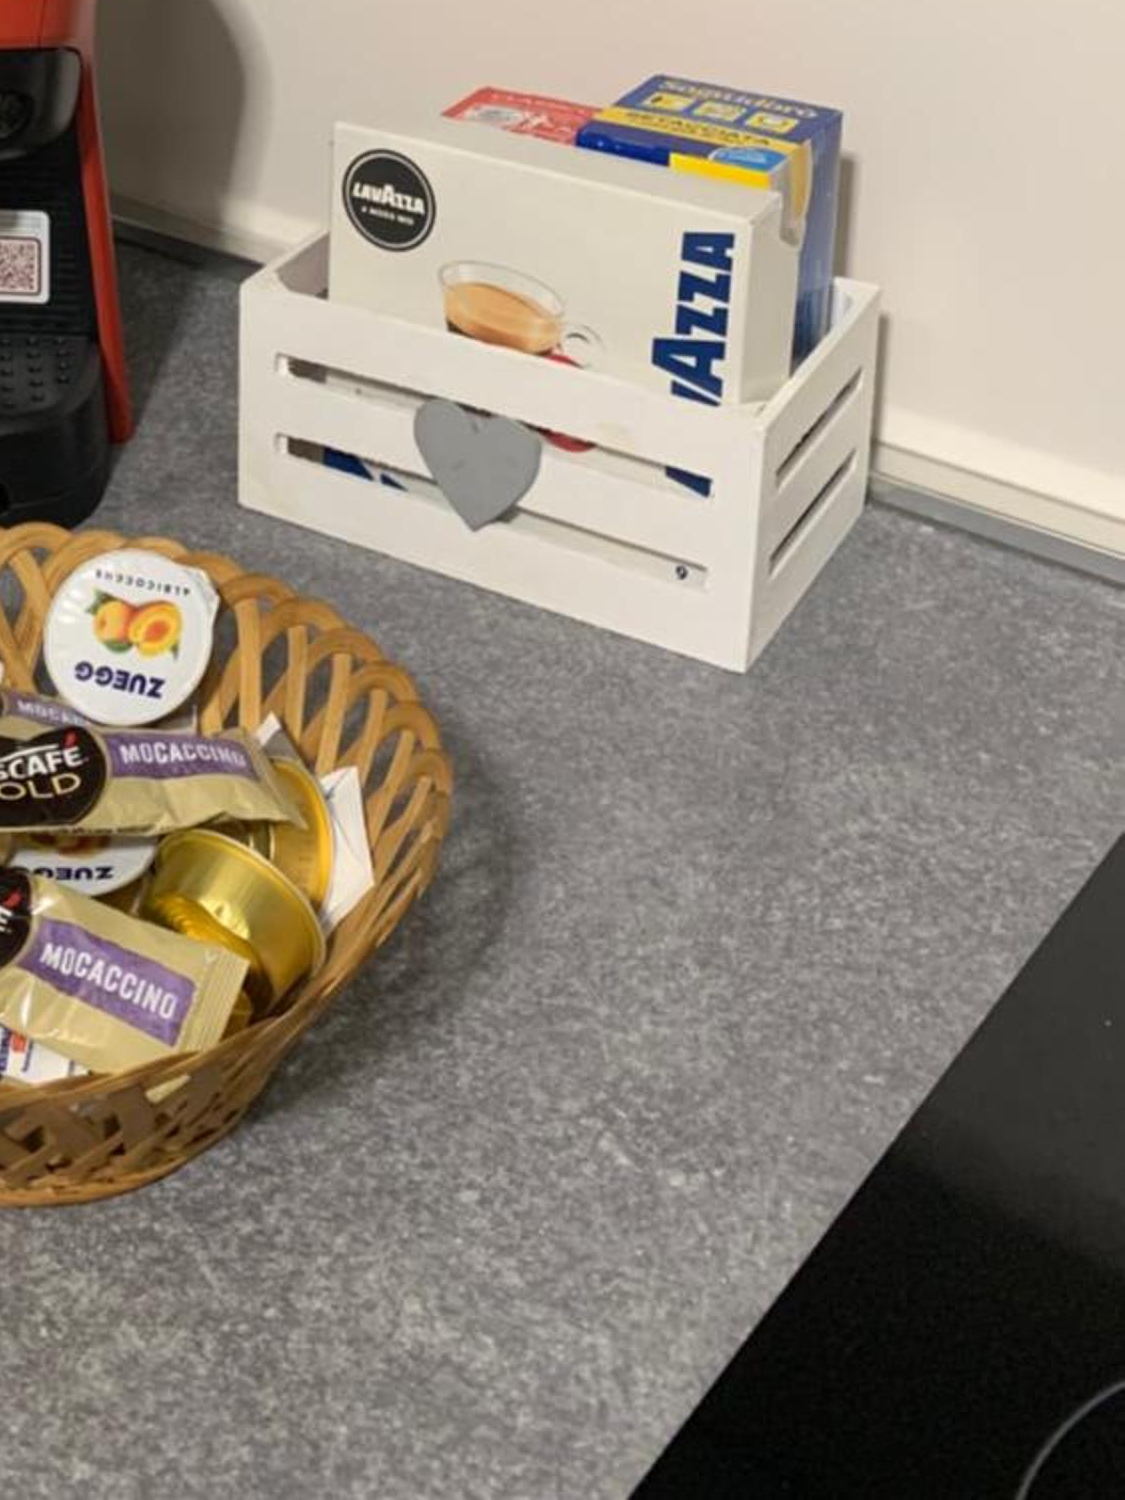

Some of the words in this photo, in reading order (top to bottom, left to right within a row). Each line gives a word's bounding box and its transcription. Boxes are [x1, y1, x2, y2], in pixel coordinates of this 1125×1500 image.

[352, 181, 426, 215] LAVAZZA
[74, 660, 166, 699] ZUEGG
[39, 942, 178, 1021] MOCACCINO
